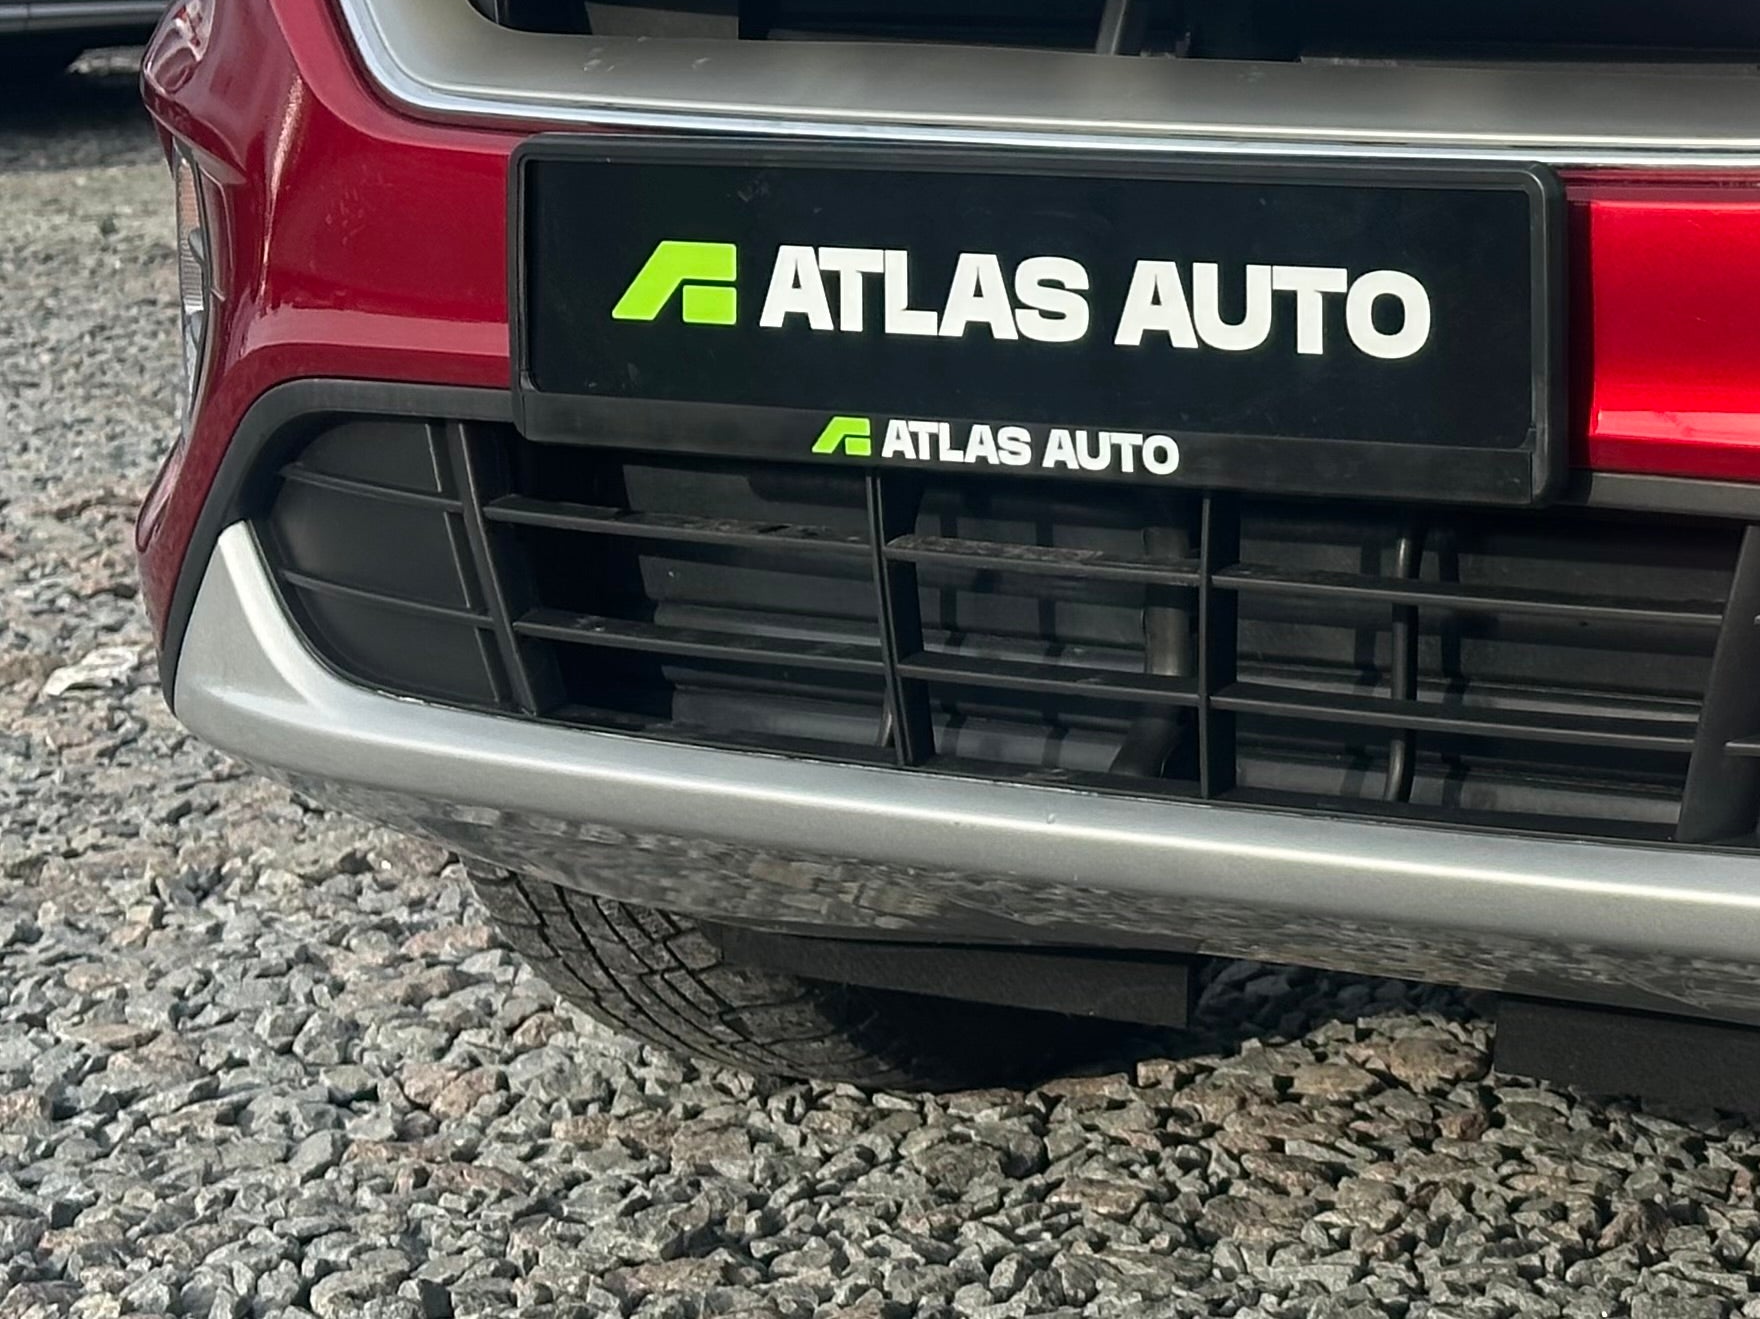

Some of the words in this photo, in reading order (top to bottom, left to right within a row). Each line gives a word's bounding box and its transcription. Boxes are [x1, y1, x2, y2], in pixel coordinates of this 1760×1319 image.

[760, 244, 1090, 343] ATLAS
[1114, 260, 1431, 359] AUTO
[881, 419, 1032, 466] ATLAS
[1042, 428, 1180, 475] AUTO
